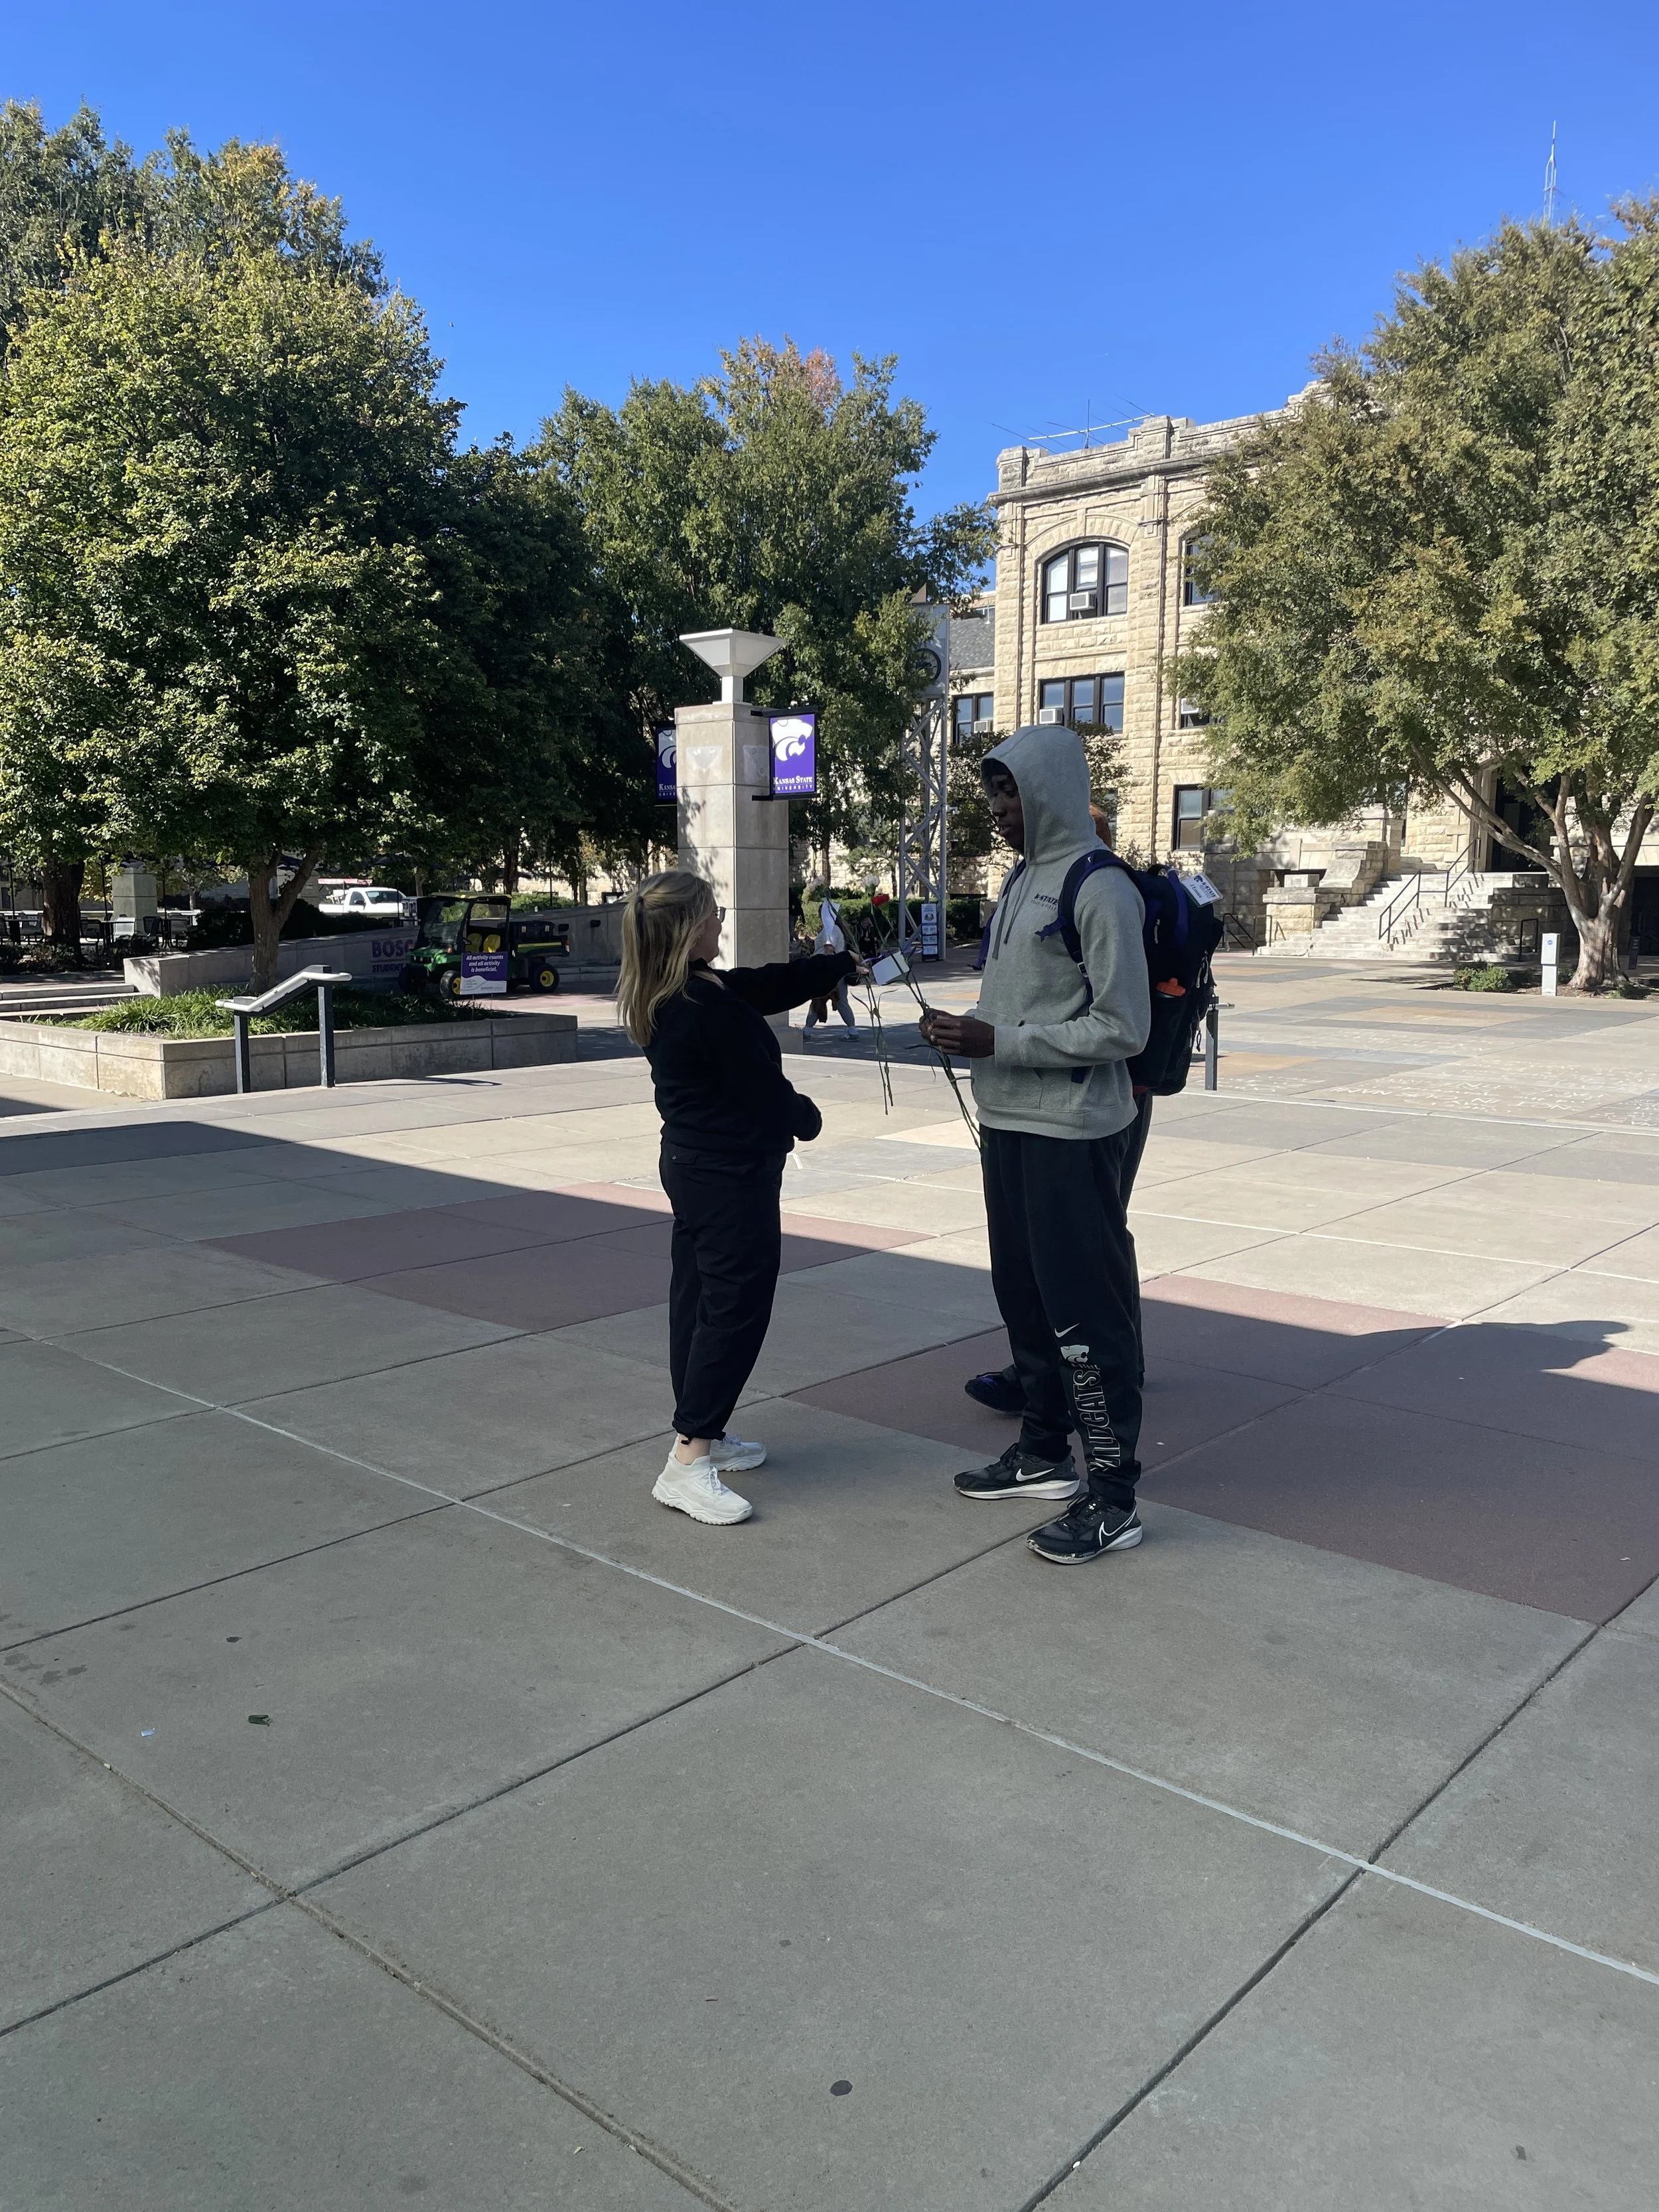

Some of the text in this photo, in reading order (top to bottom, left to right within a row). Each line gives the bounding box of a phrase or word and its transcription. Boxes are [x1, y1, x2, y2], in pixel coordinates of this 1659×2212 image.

[773, 775, 813, 785] KANSAS STATE
[1034, 893, 1058, 906] K-STATE
